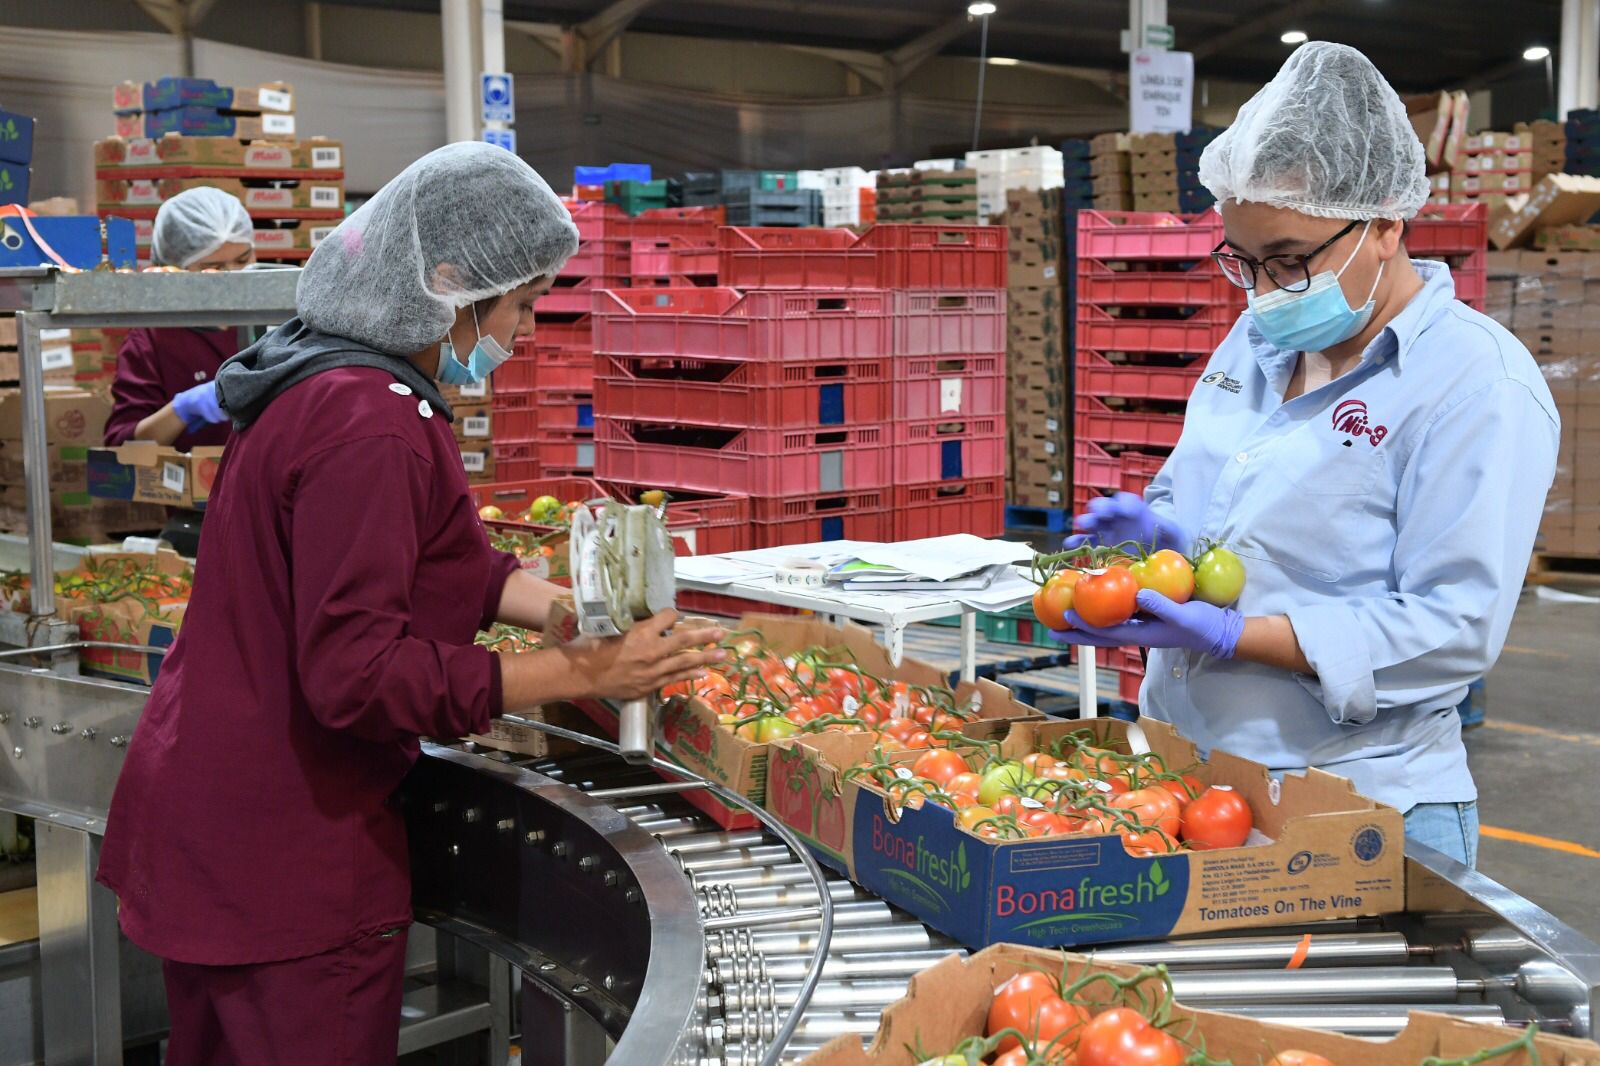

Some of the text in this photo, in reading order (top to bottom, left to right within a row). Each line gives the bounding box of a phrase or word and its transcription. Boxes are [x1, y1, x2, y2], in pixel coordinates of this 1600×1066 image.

[872, 815, 960, 893] Bonafresh
[997, 872, 1153, 917] Bonafresh
[1199, 904, 1269, 921] Tomatoes
[1274, 900, 1295, 914] On
[1299, 897, 1326, 911] The
[1330, 895, 1362, 909] Vine
[1027, 921, 1123, 938] High Tech Greenhouses
